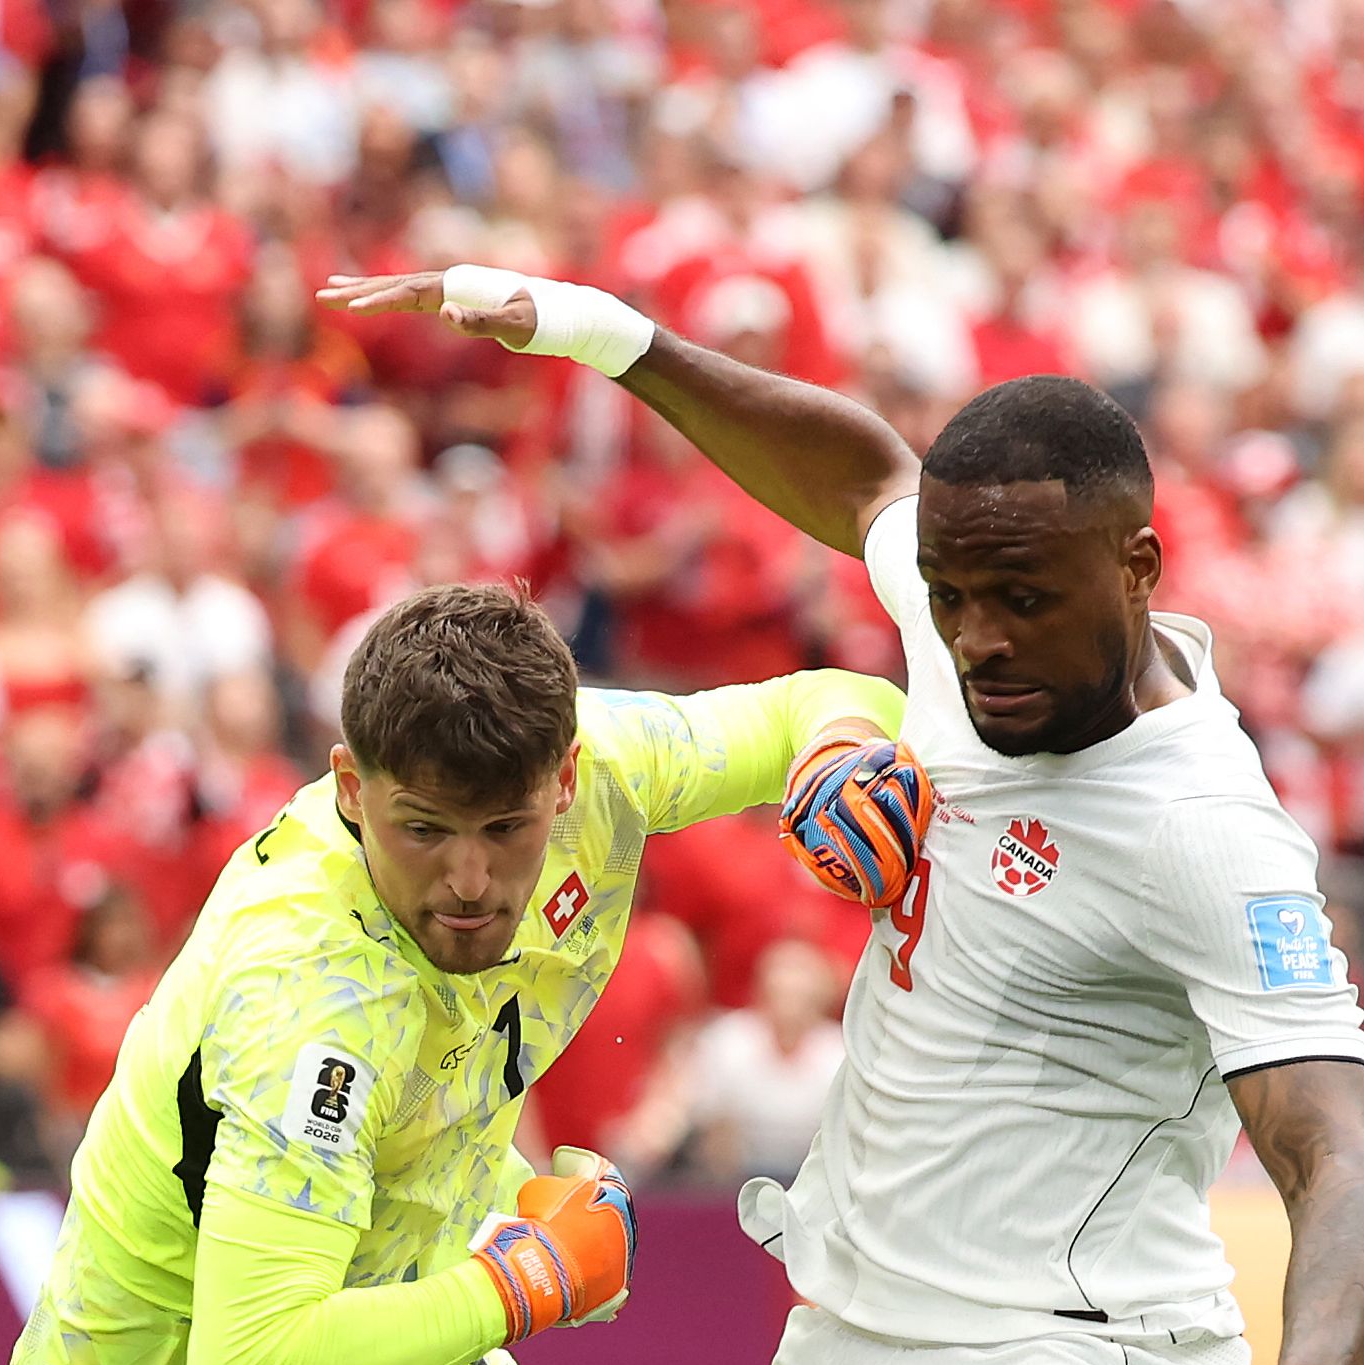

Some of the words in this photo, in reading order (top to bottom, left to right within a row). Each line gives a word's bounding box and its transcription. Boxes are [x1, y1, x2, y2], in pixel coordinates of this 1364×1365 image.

[998, 835, 1055, 881] CANADA
[890, 857, 931, 992] 9
[1281, 953, 1321, 970] PEACE
[491, 990, 525, 1101] 1
[319, 1105, 339, 1119] FIFA
[303, 1125, 341, 1144] 2026
